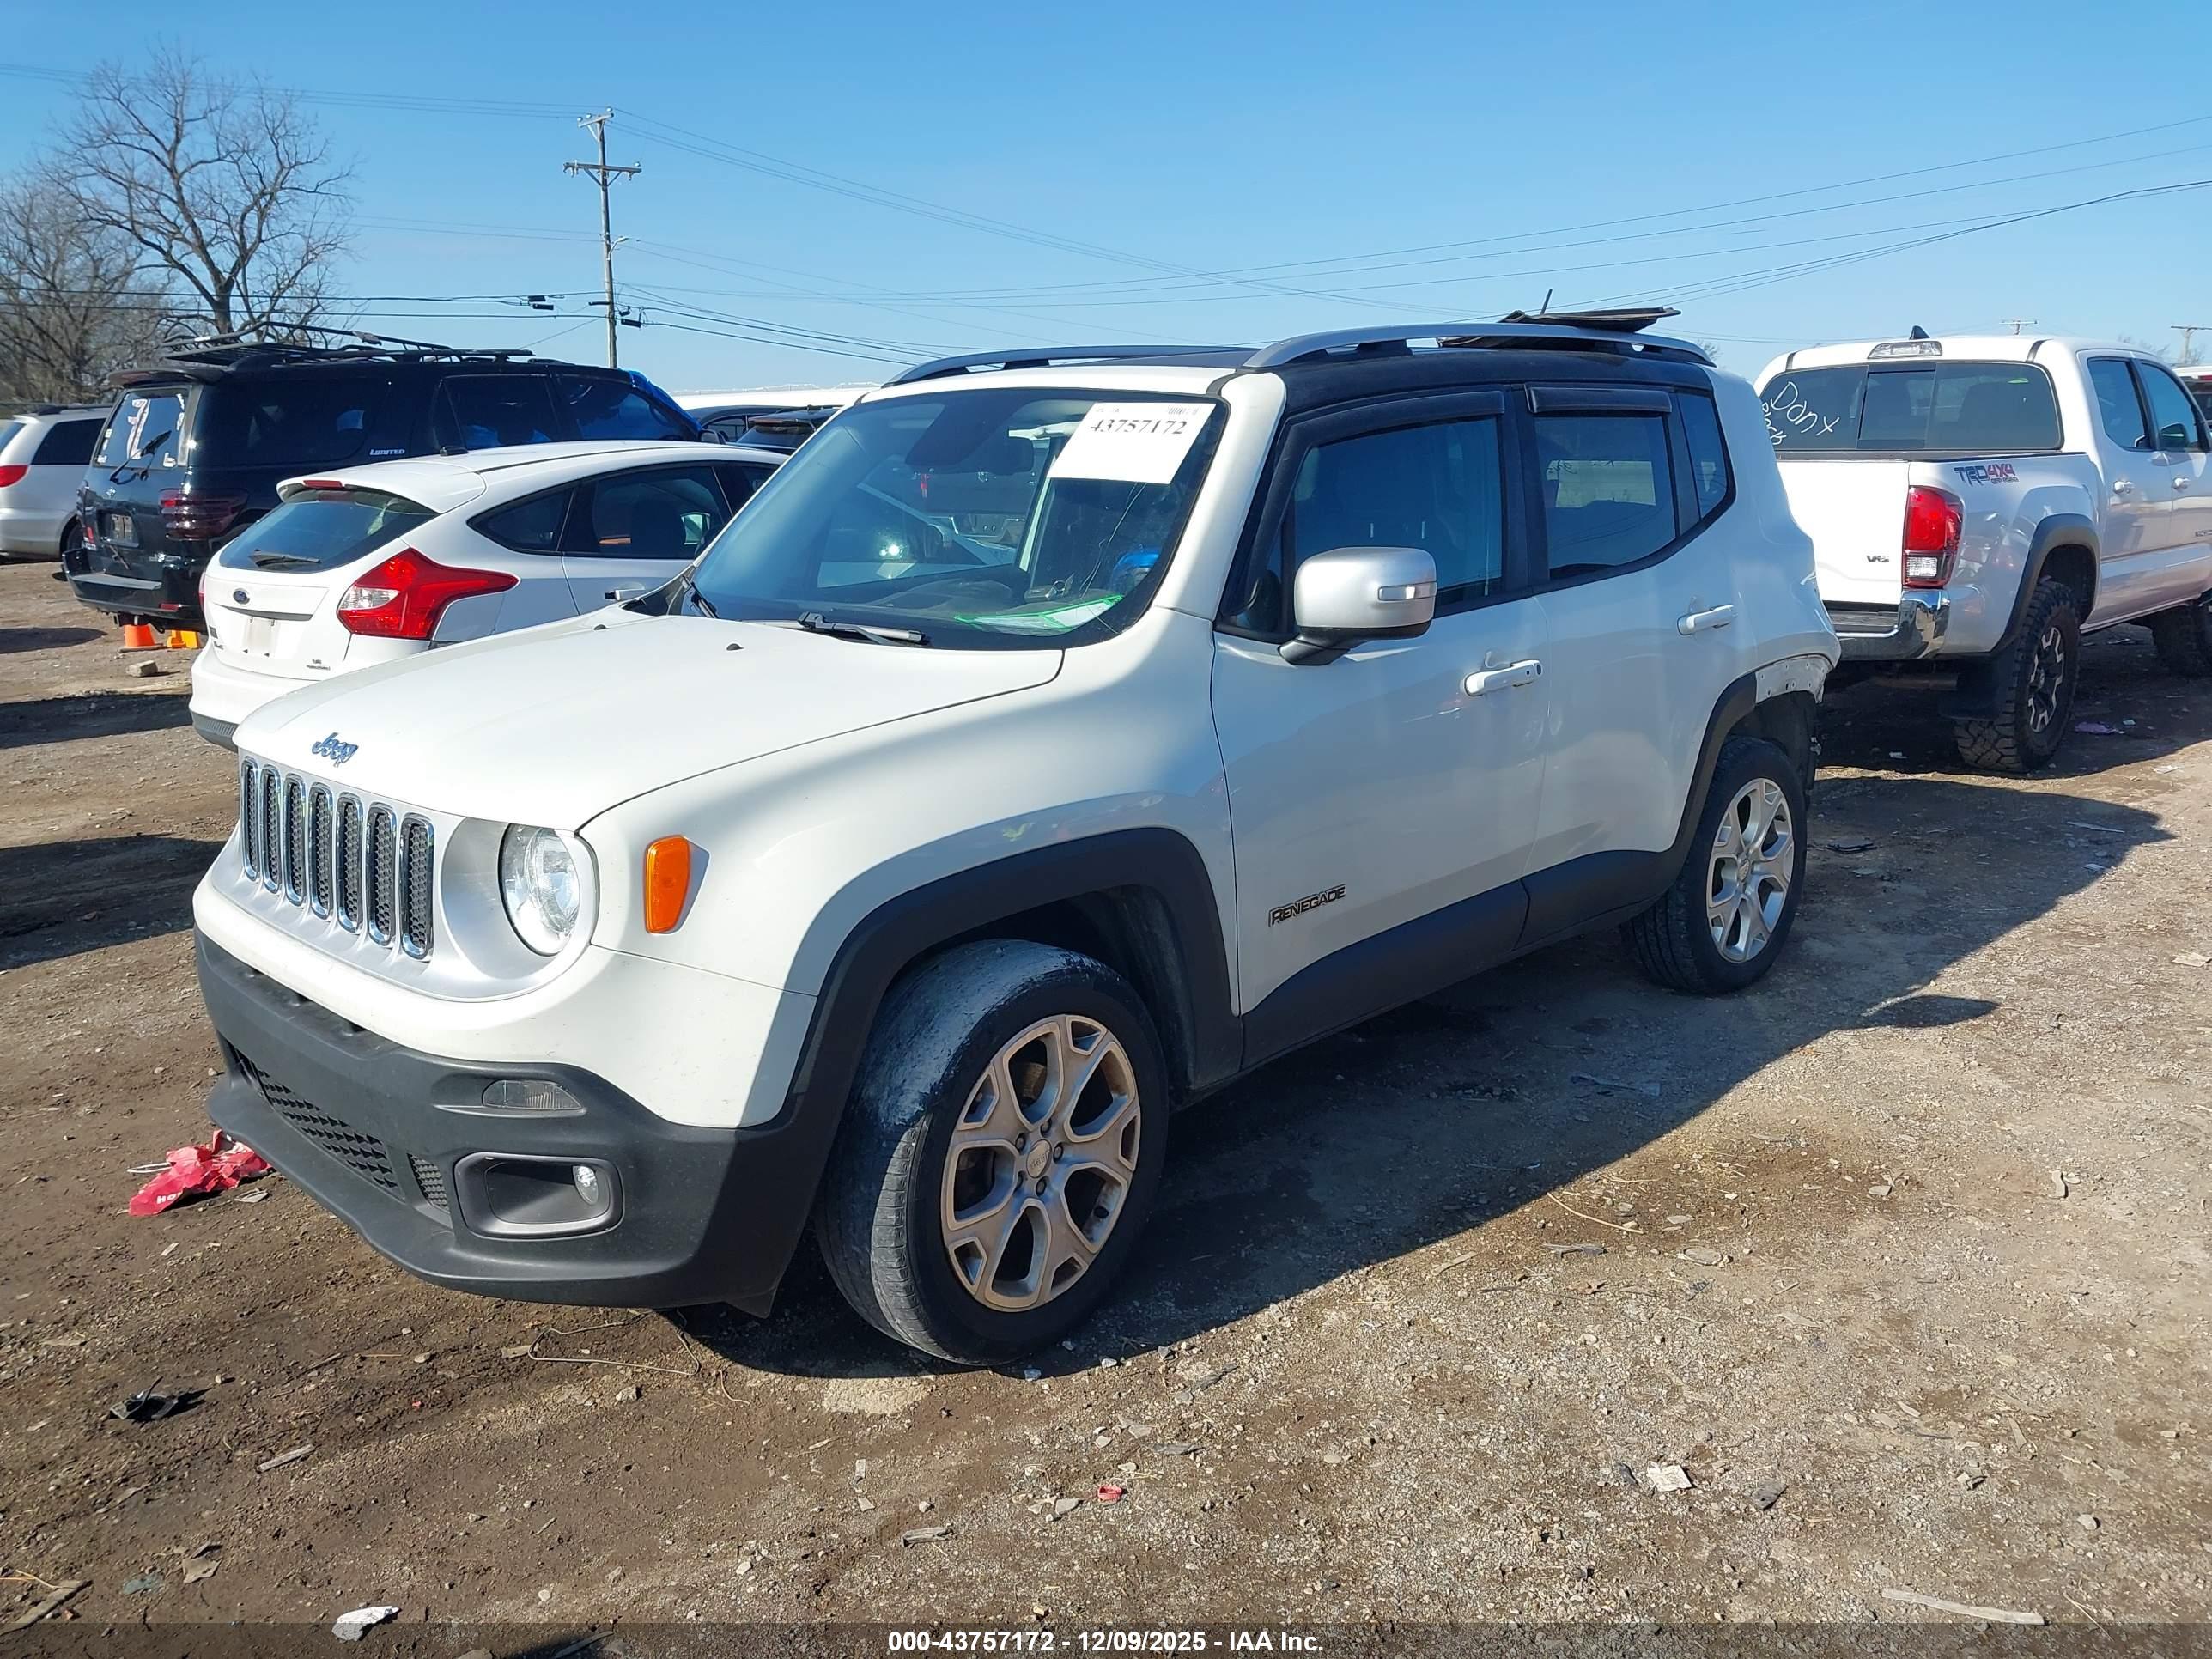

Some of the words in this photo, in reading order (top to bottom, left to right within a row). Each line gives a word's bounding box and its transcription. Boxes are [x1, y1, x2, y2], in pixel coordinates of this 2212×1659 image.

[1090, 418, 1188, 435] 43757172
[1954, 465, 1989, 487] TRD
[311, 732, 359, 768] Jeep
[1269, 884, 1346, 927] RENEGADE
